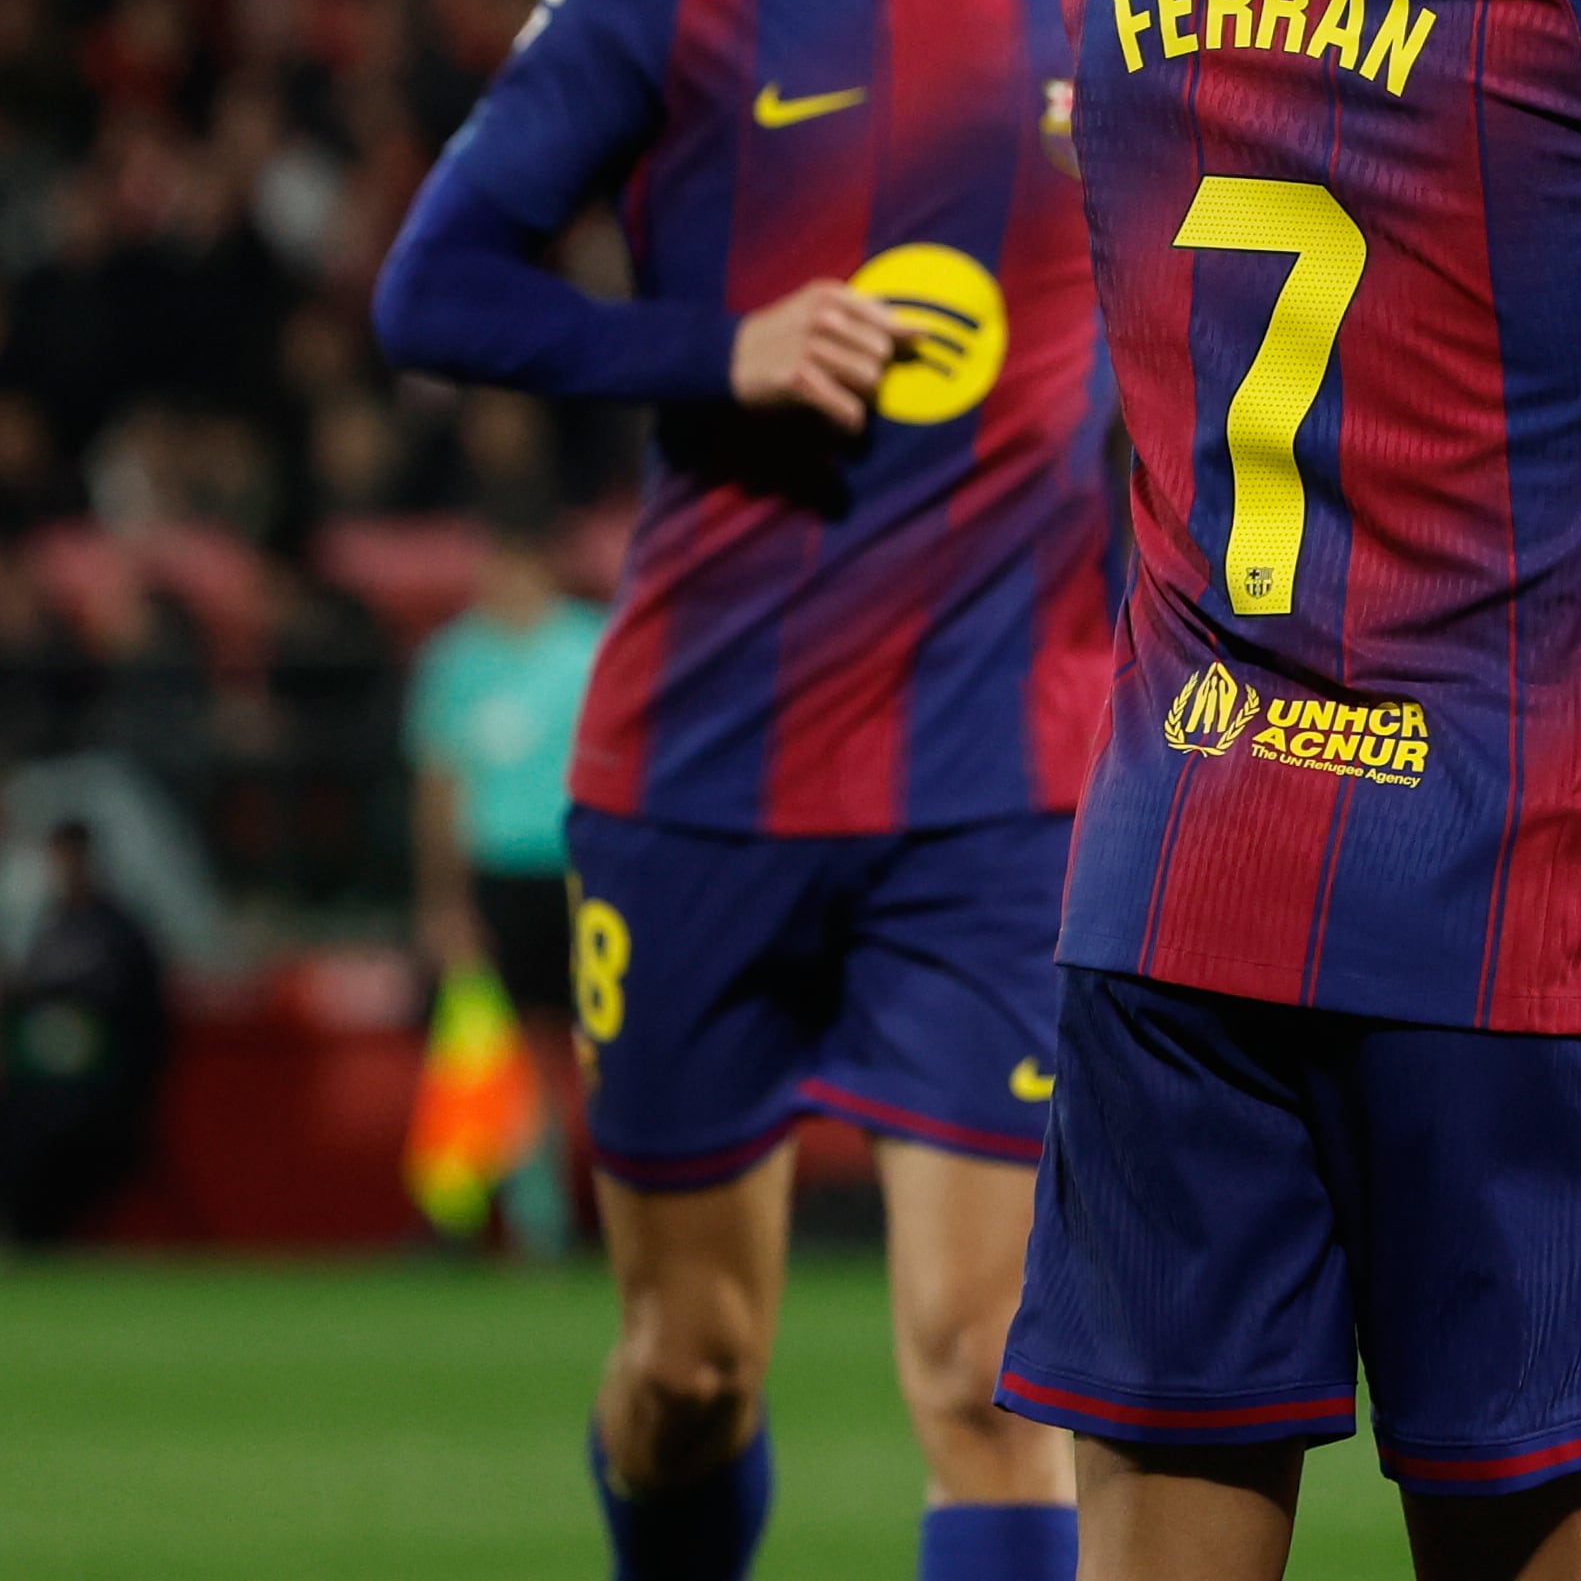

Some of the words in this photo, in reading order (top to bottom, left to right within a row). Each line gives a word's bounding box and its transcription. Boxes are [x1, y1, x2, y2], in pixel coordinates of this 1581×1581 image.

[1171, 174, 1368, 616] 7
[1266, 698, 1429, 738] UNHCR
[1251, 743, 1277, 761] The
[1279, 753, 1303, 767] UN
[1303, 759, 1364, 777] Refugee
[1365, 768, 1421, 789] Agency
[1252, 726, 1429, 772] ACNUR
